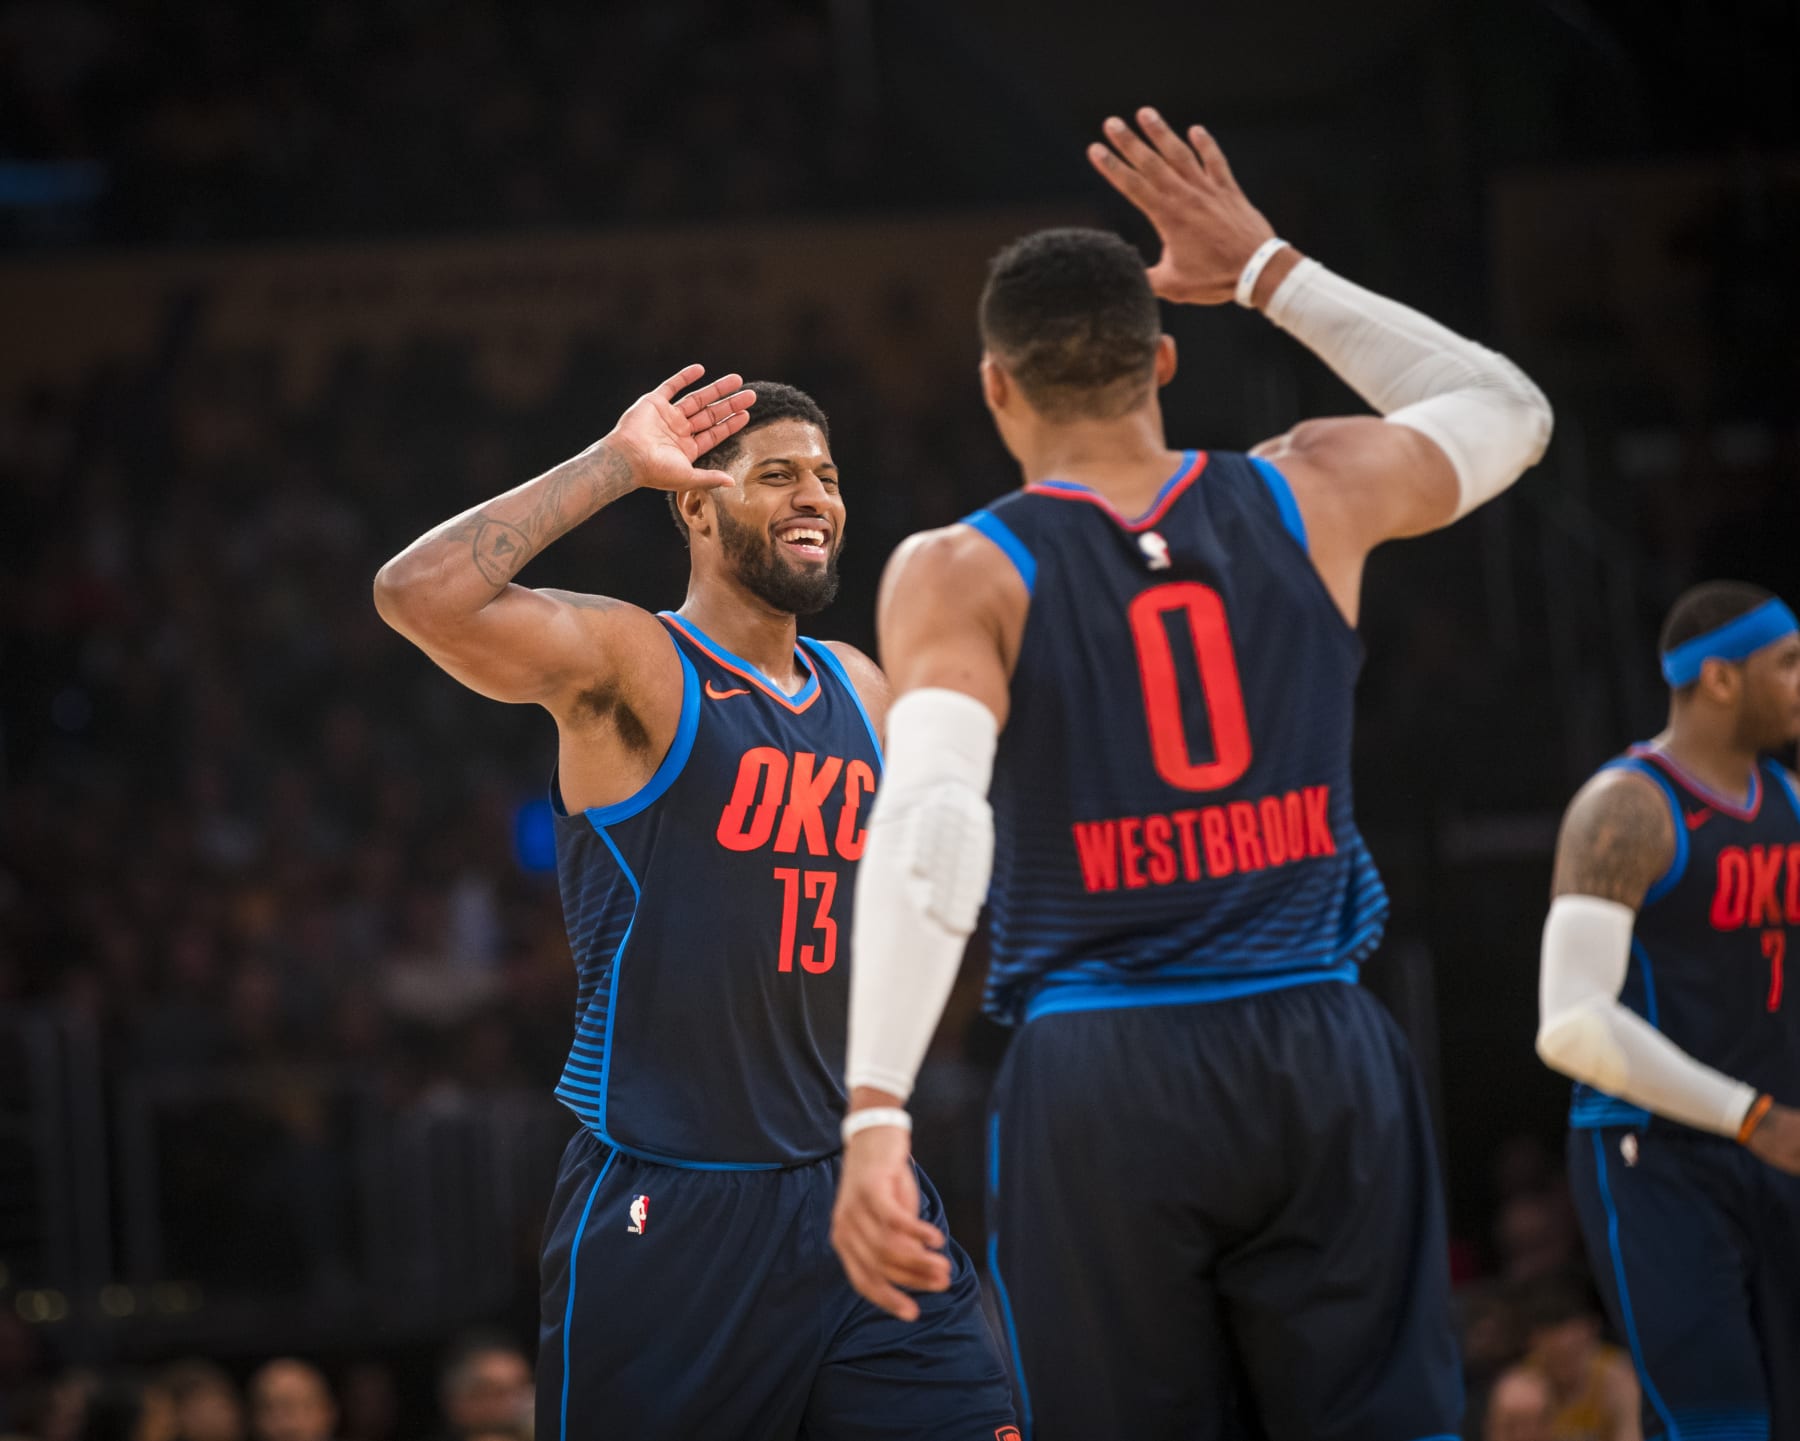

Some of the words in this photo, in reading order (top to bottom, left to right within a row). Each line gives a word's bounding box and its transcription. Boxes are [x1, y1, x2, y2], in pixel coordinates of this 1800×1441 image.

[1128, 581, 1252, 791] 0
[716, 746, 875, 862] OKC
[1072, 785, 1336, 893] WESTBROOK
[773, 867, 838, 975] 13
[1761, 929, 1786, 1012] 7
